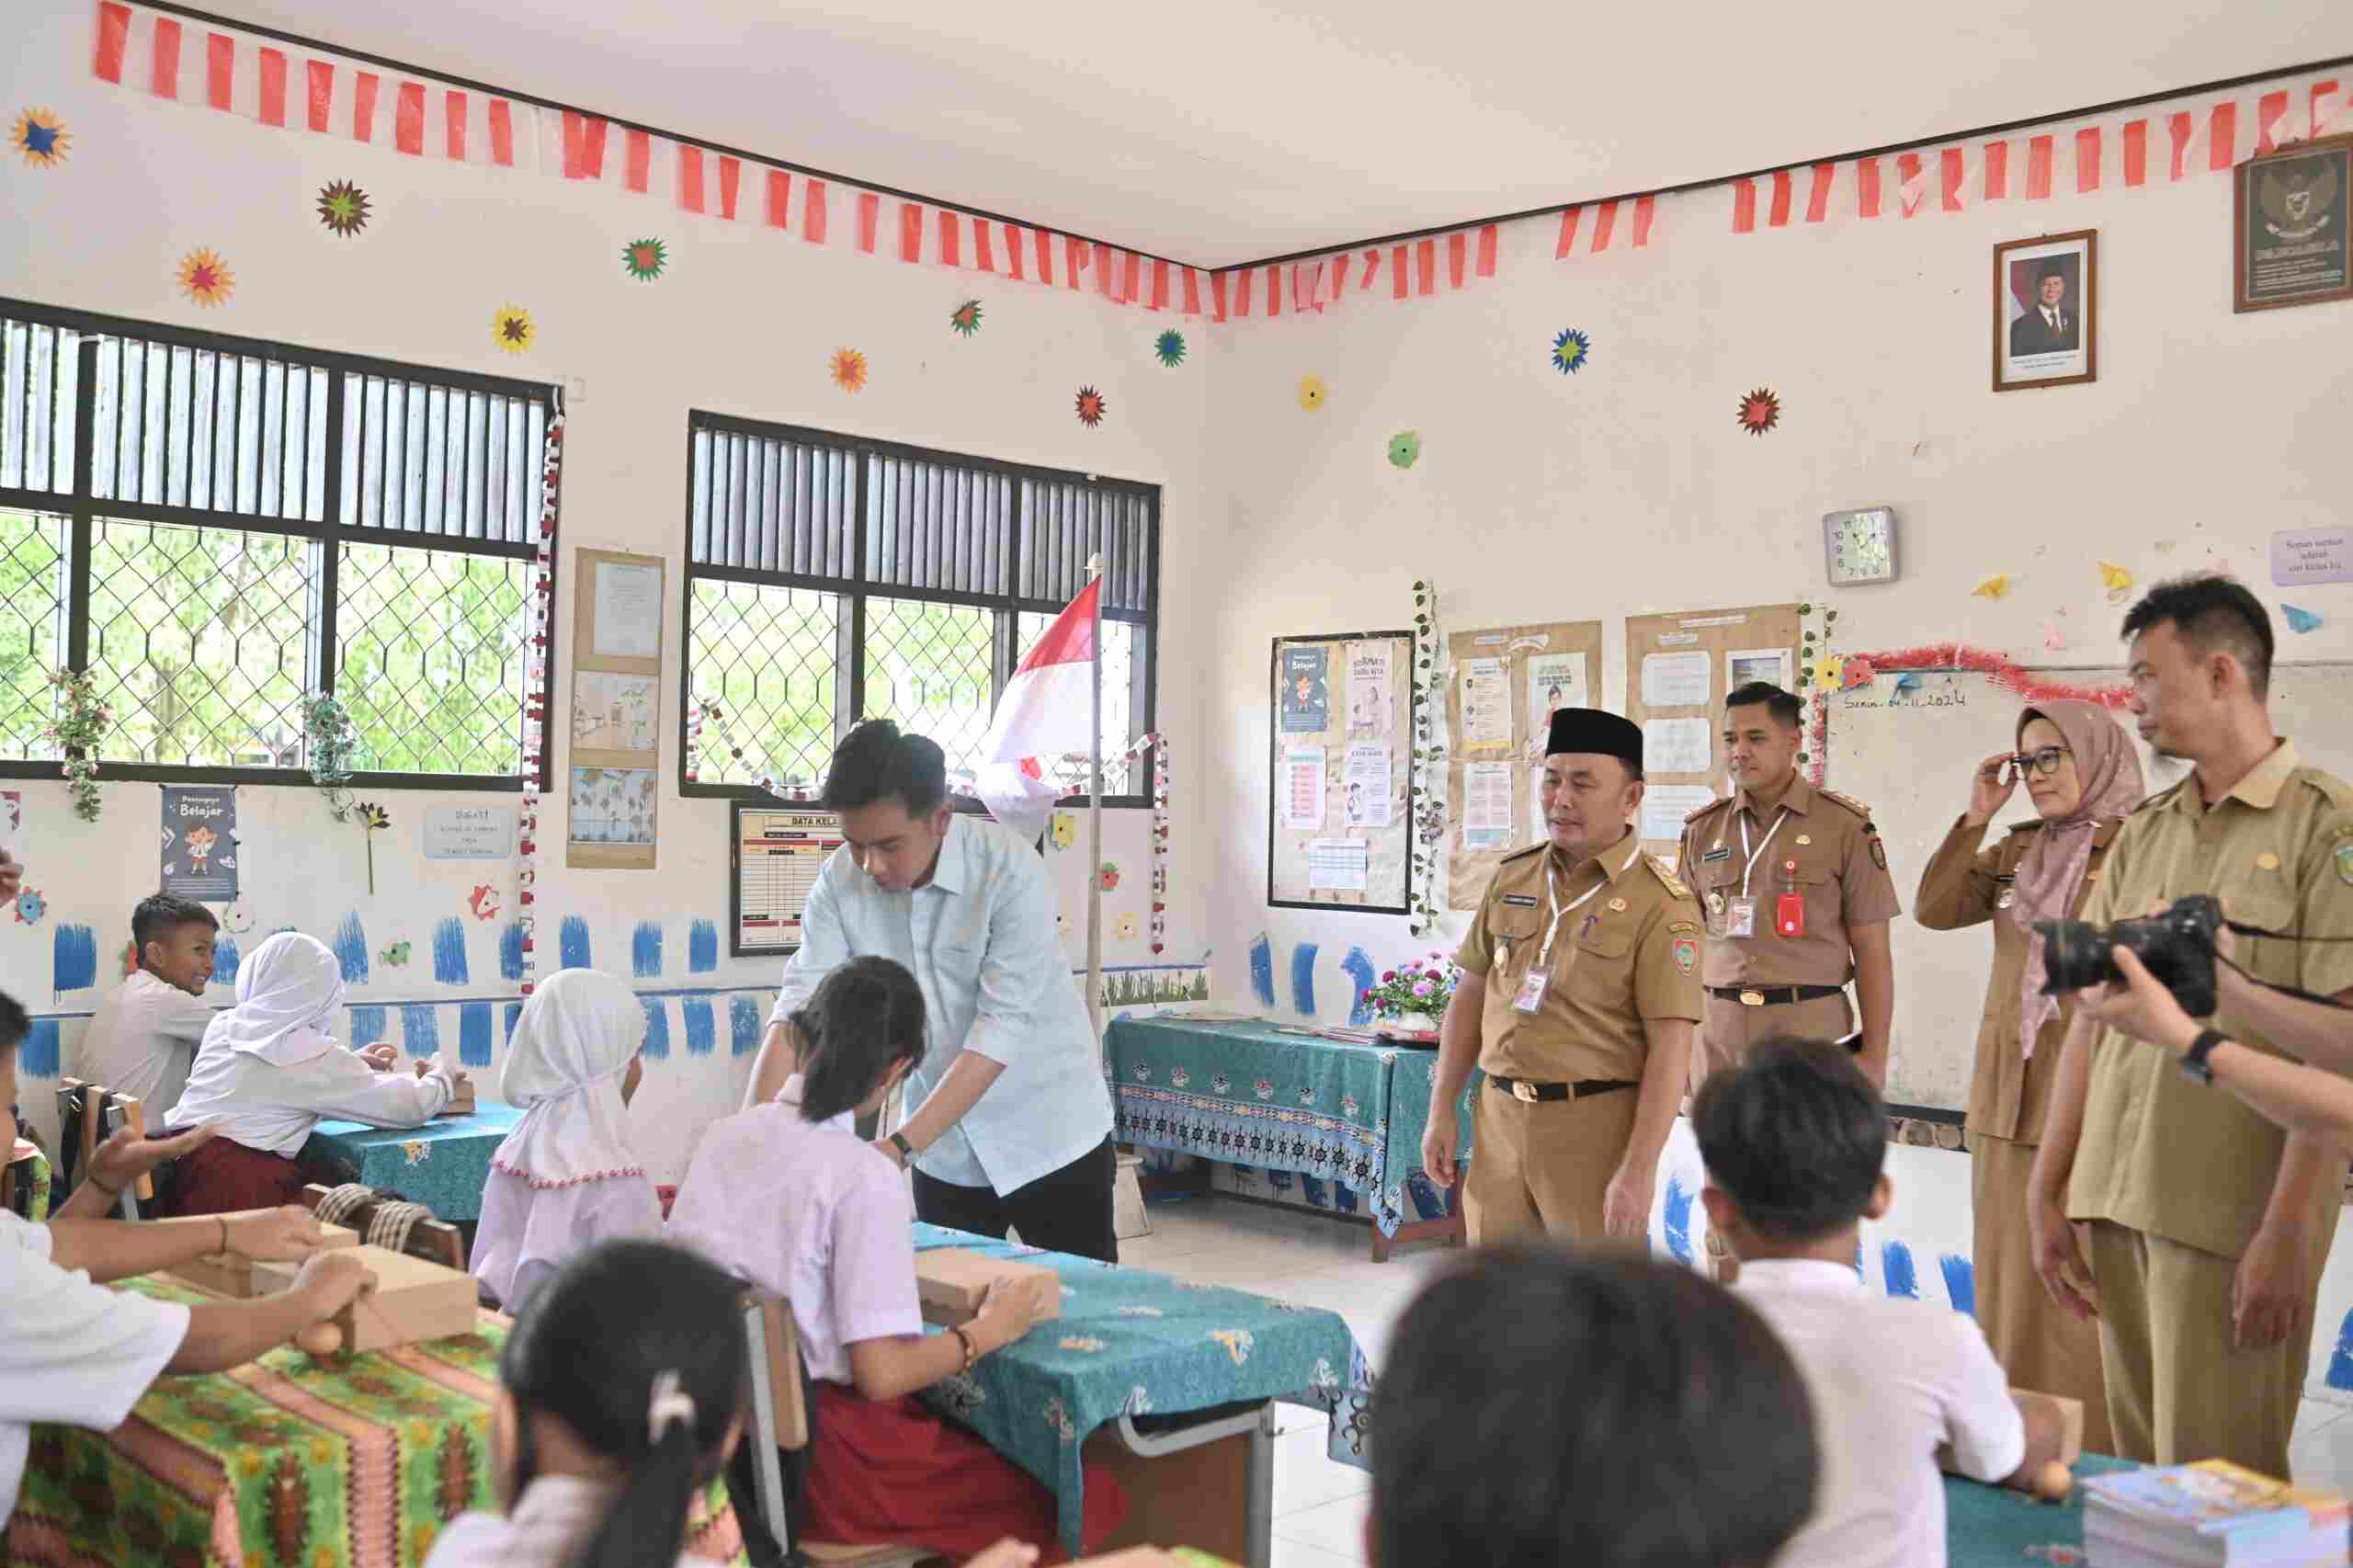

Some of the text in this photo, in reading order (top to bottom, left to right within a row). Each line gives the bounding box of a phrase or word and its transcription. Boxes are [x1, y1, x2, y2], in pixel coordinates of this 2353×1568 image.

[1292, 661, 1316, 671] Belajar
[180, 804, 223, 818] Belajar
[792, 816, 813, 825] DATA
